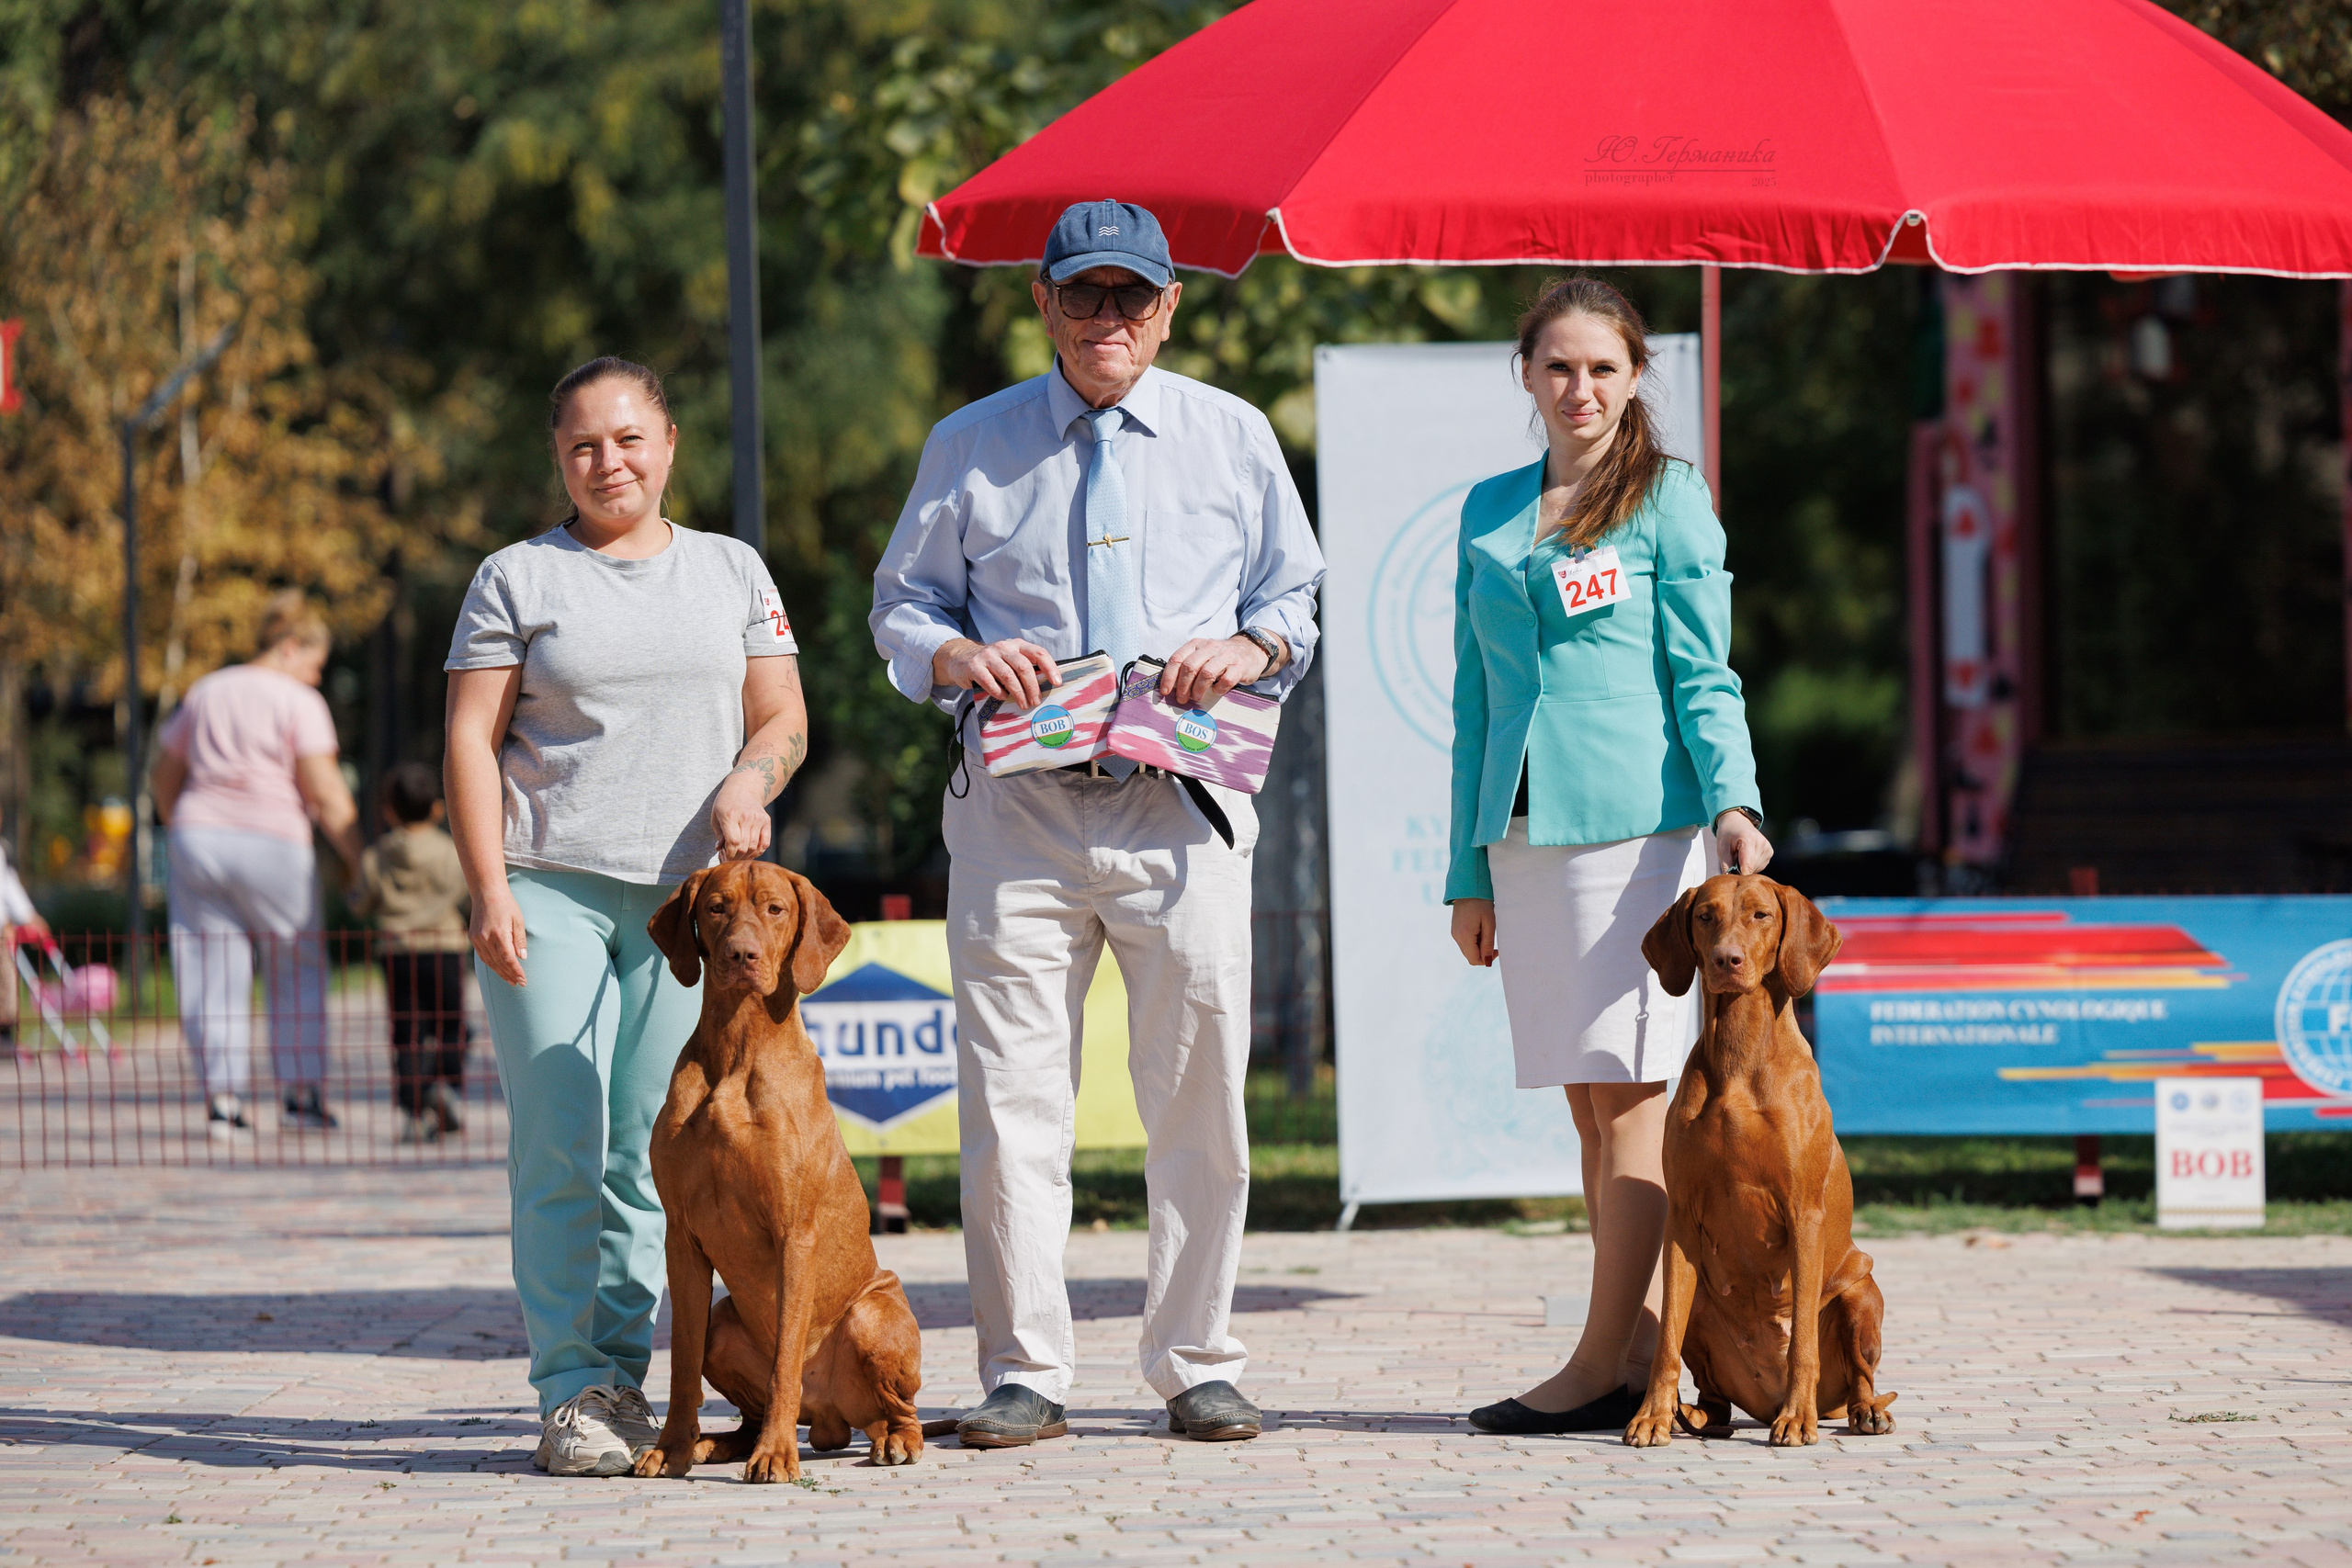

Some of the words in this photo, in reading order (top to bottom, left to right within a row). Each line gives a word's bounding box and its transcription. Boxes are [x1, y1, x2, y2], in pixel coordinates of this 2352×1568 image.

[1565, 568, 1618, 609] 247
[1040, 719, 1066, 734] BOB
[1184, 722, 1209, 740] BOS
[1871, 1023, 2059, 1045] INTERNATIONALE
[2171, 1150, 2254, 1179] BOB
